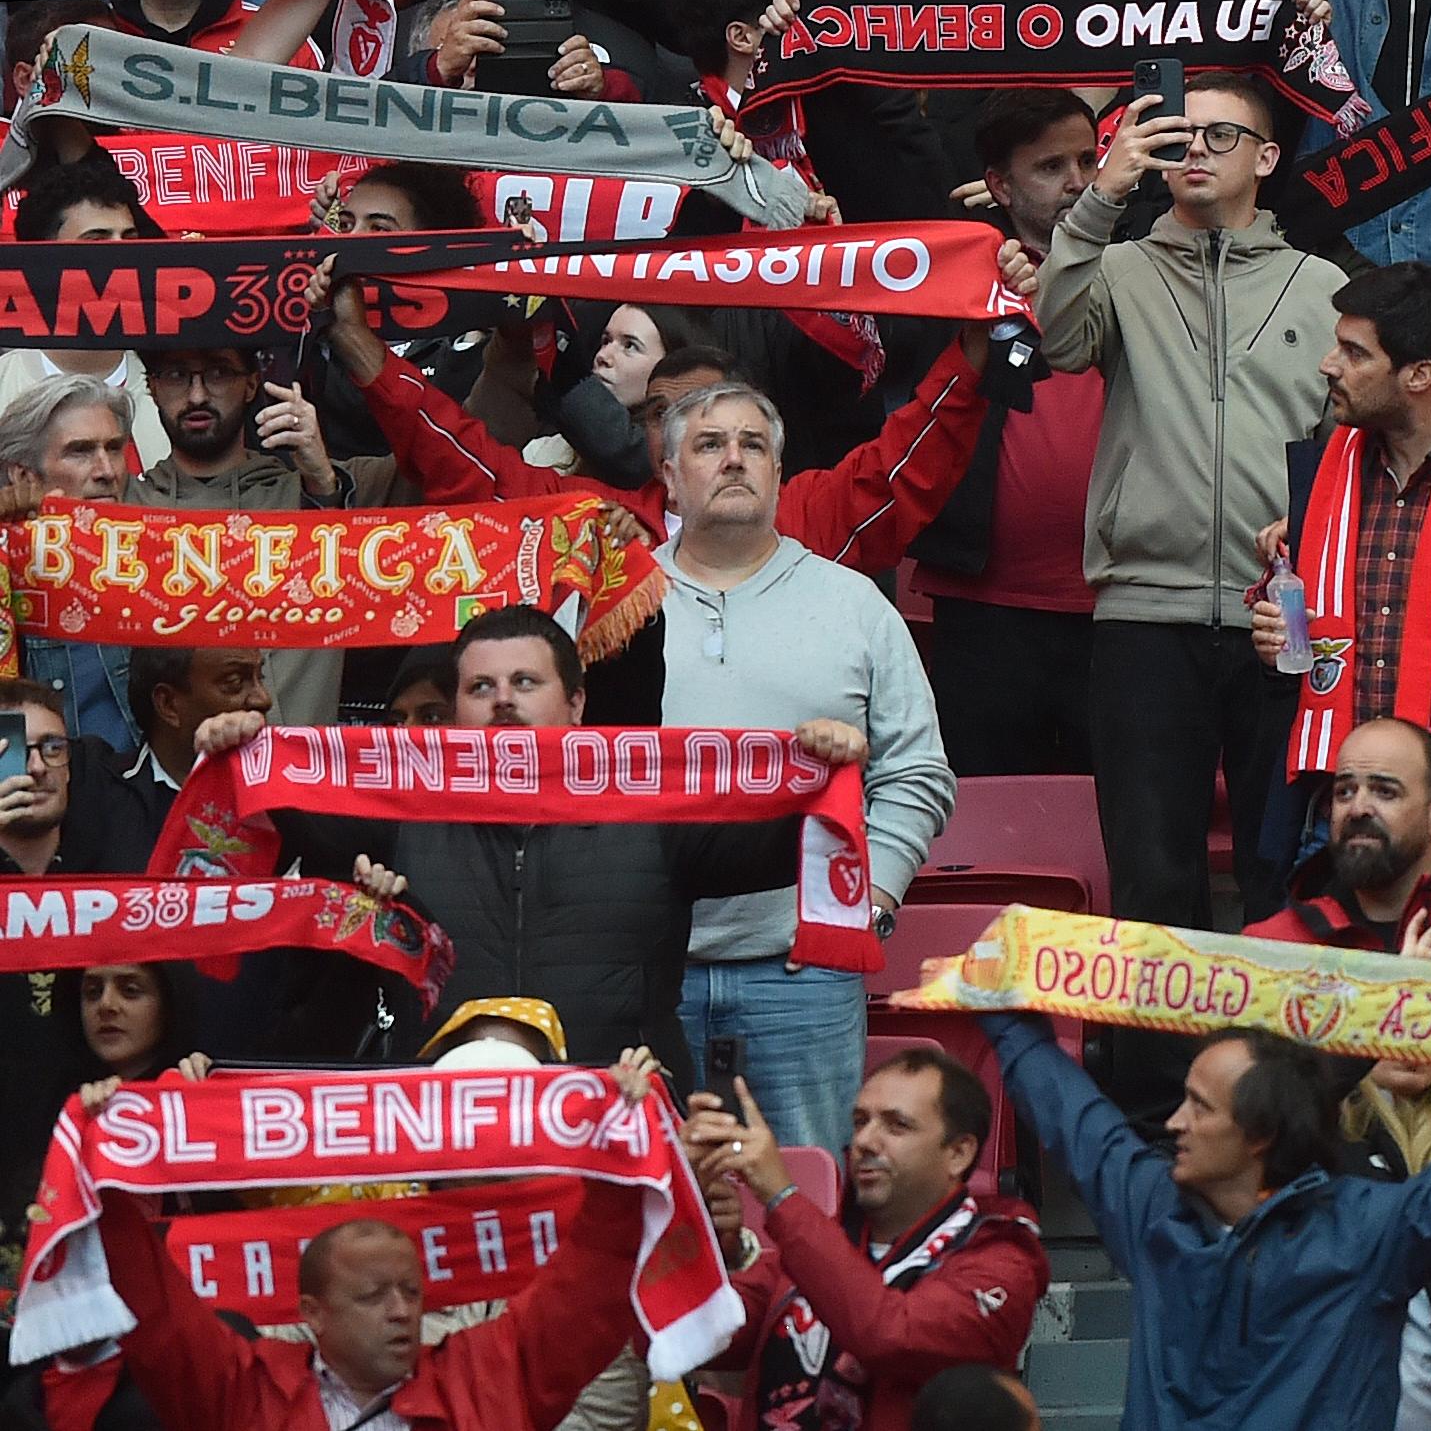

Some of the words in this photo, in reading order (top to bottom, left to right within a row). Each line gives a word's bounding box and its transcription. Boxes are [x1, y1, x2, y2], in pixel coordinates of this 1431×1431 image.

[25, 514, 488, 599] BENFICA
[239, 725, 541, 796] BENFICA
[561, 730, 662, 795] DO
[684, 729, 830, 796] SOU
[98, 1089, 218, 1169] SL
[242, 1070, 653, 1161] BENFICA
